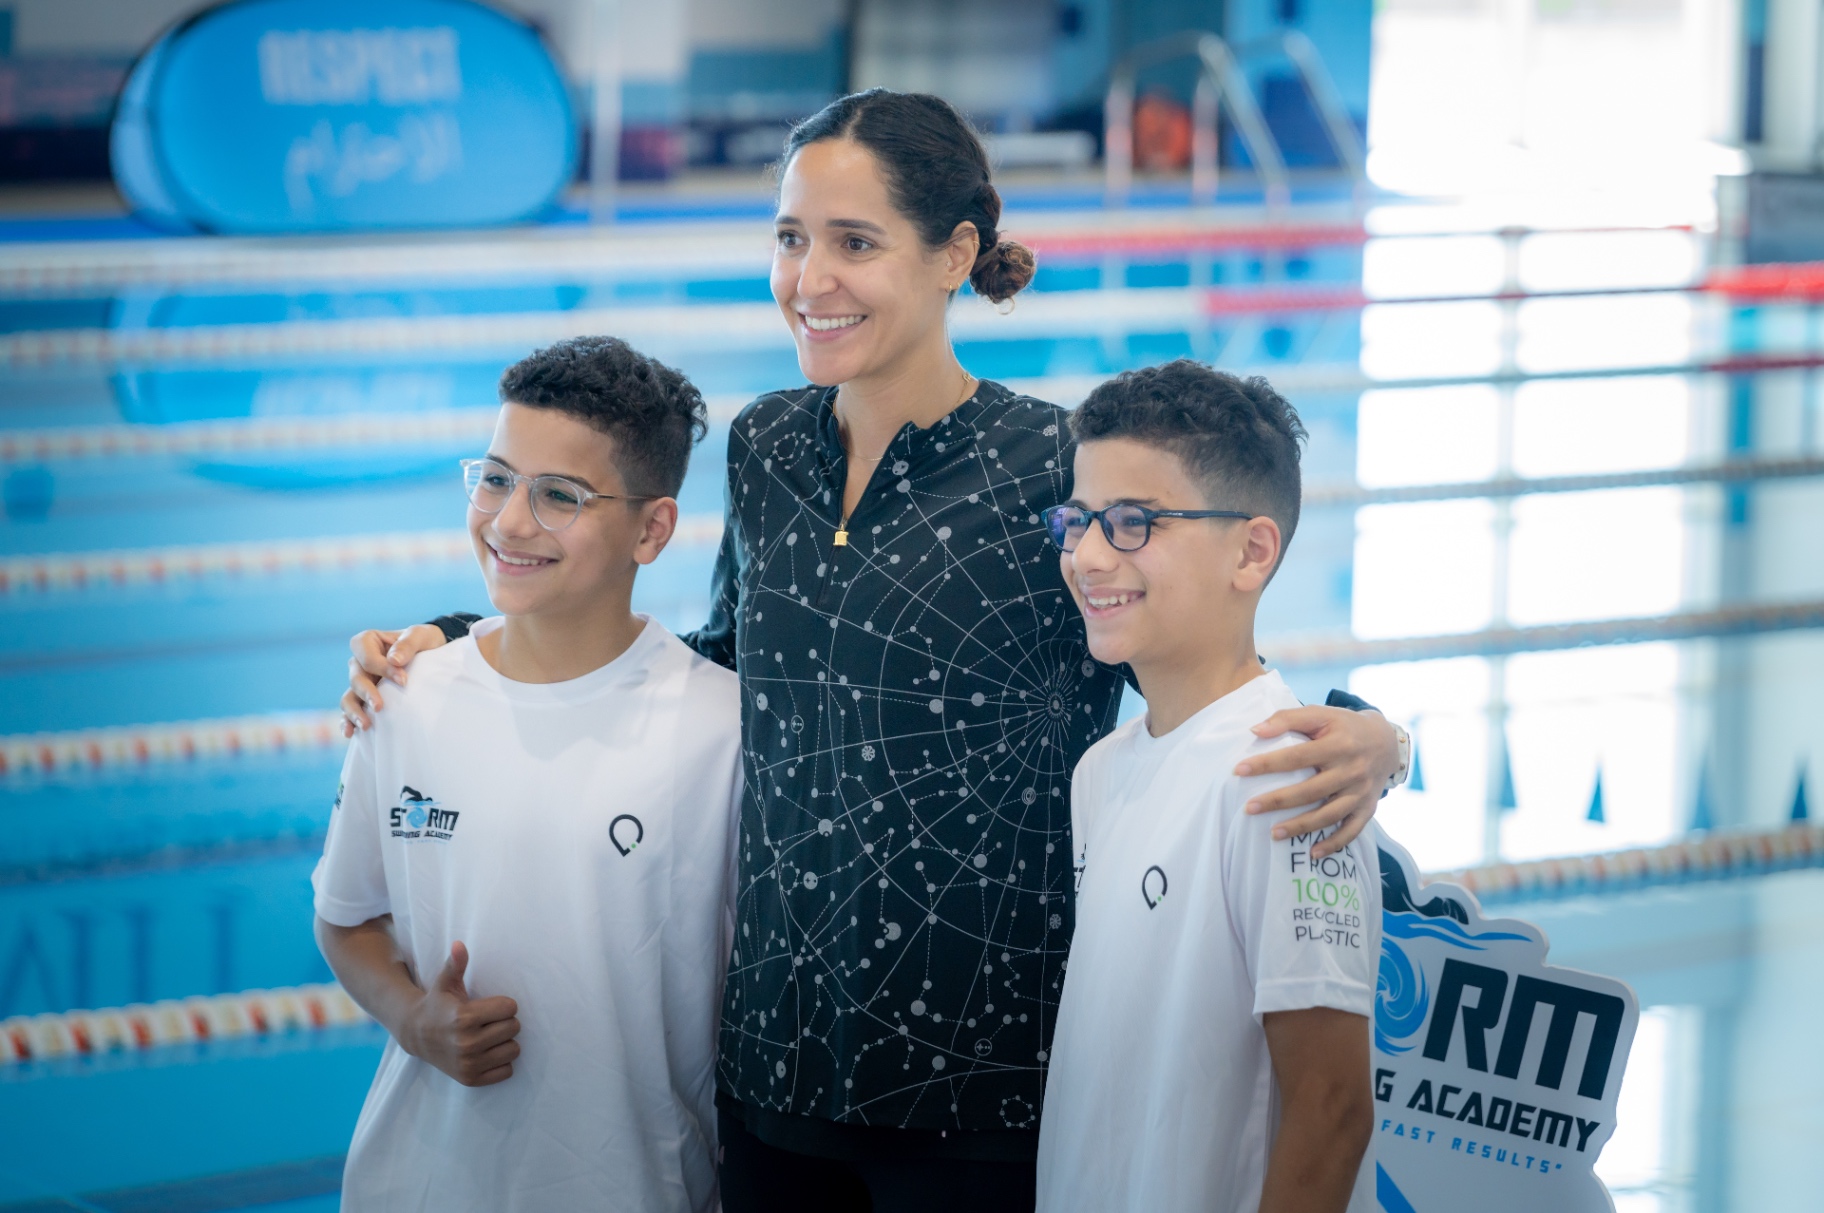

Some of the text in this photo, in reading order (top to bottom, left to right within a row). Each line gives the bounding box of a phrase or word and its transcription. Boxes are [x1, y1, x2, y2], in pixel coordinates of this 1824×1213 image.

[1291, 851, 1358, 882] FROM
[1292, 878, 1360, 912] 100%
[1381, 1119, 1436, 1144] FAST
[1406, 1078, 1600, 1153] ACADEMY
